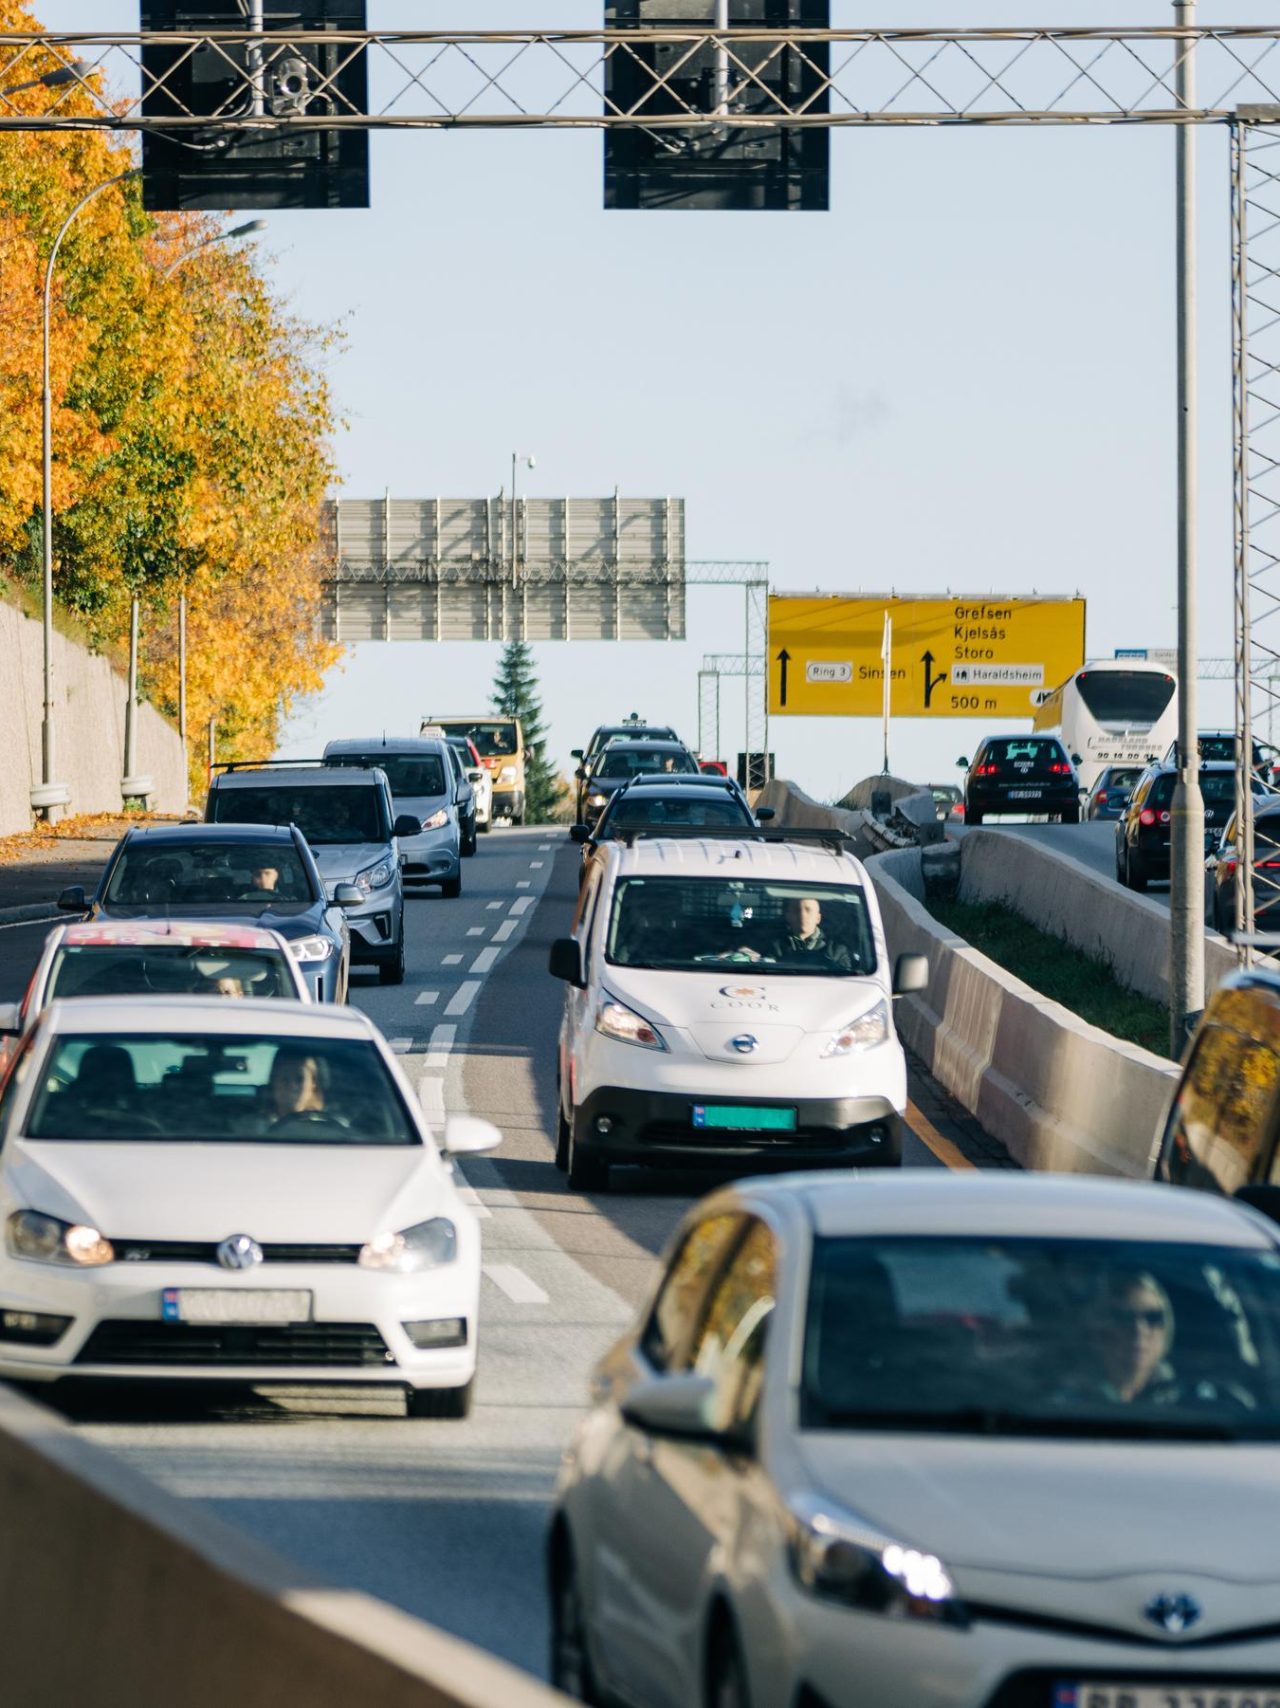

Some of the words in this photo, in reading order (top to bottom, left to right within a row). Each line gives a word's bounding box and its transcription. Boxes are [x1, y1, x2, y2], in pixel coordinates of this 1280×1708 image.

[954, 606, 1012, 620] Grefsen
[954, 626, 1006, 642] Kjelsås
[954, 646, 994, 660] Storo
[813, 666, 835, 678] Ring
[840, 666, 846, 677] 3
[973, 669, 1042, 680] Haraldsheim
[951, 696, 979, 709] 500
[985, 698, 997, 709] m
